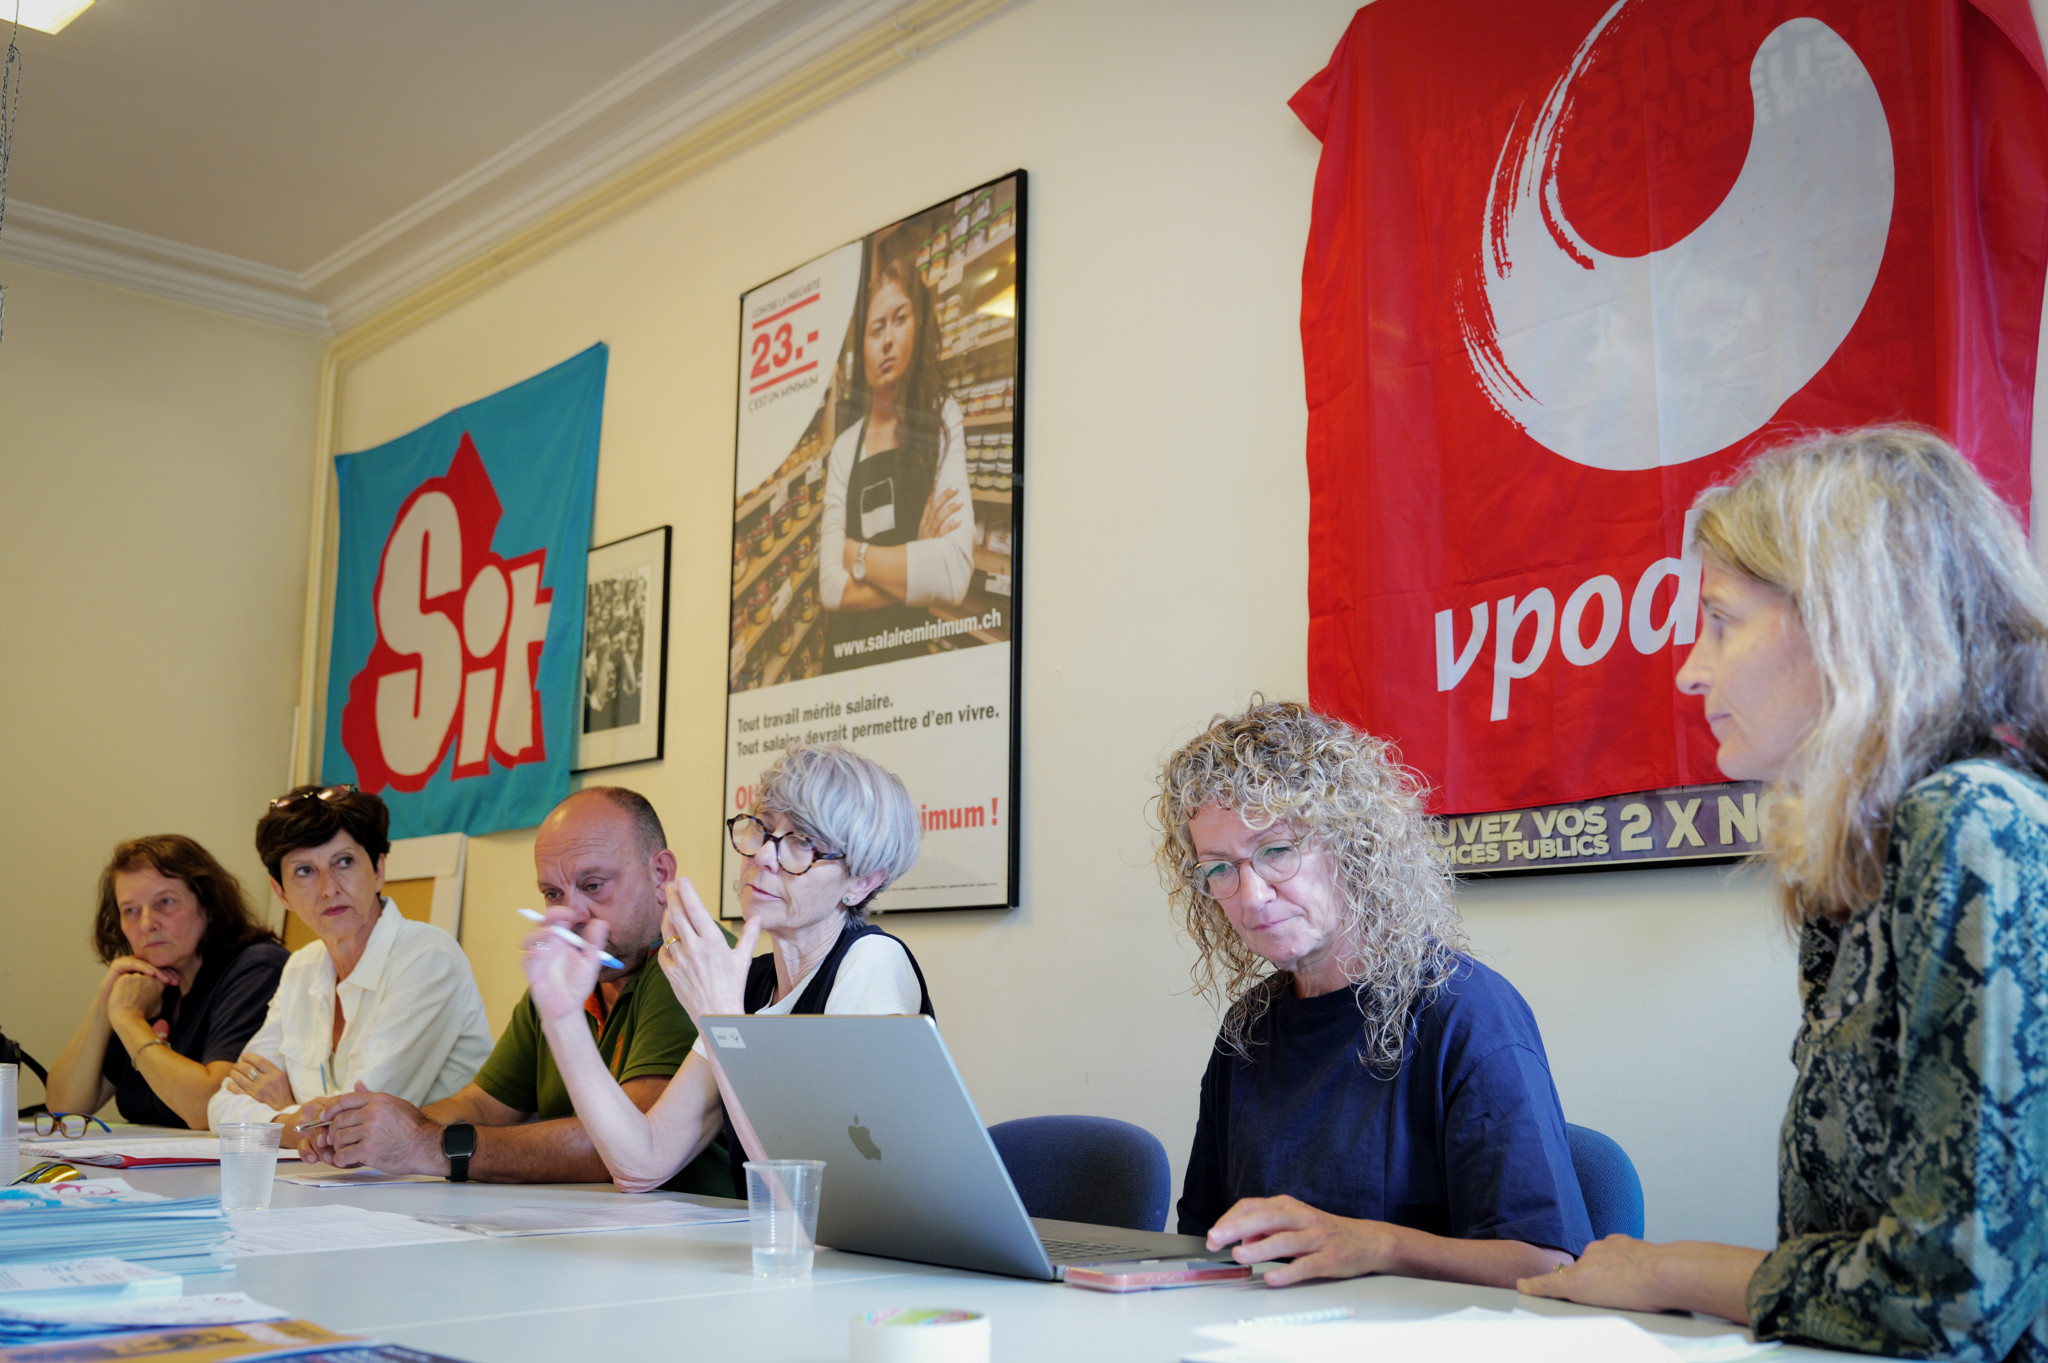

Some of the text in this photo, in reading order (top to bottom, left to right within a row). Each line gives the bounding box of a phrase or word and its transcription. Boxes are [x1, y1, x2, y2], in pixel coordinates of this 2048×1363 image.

[750, 322, 819, 381] 23.-
[376, 490, 552, 777] Sit
[833, 608, 1002, 659] www.salaireminimum.ch
[1435, 507, 1703, 722] vpod
[737, 693, 894, 733] Tout travail mérite salaire.
[737, 739, 759, 757] Tout
[805, 723, 847, 745] devrait
[852, 715, 917, 742] permettre
[922, 709, 953, 728] d'en
[958, 704, 1000, 723] vivre.
[919, 797, 998, 832] imum !
[1433, 805, 1608, 847] UVEZ VOS
[1619, 802, 1654, 852] 2
[1664, 798, 1706, 849] X
[1443, 834, 1610, 865] ICES PUBLICS
